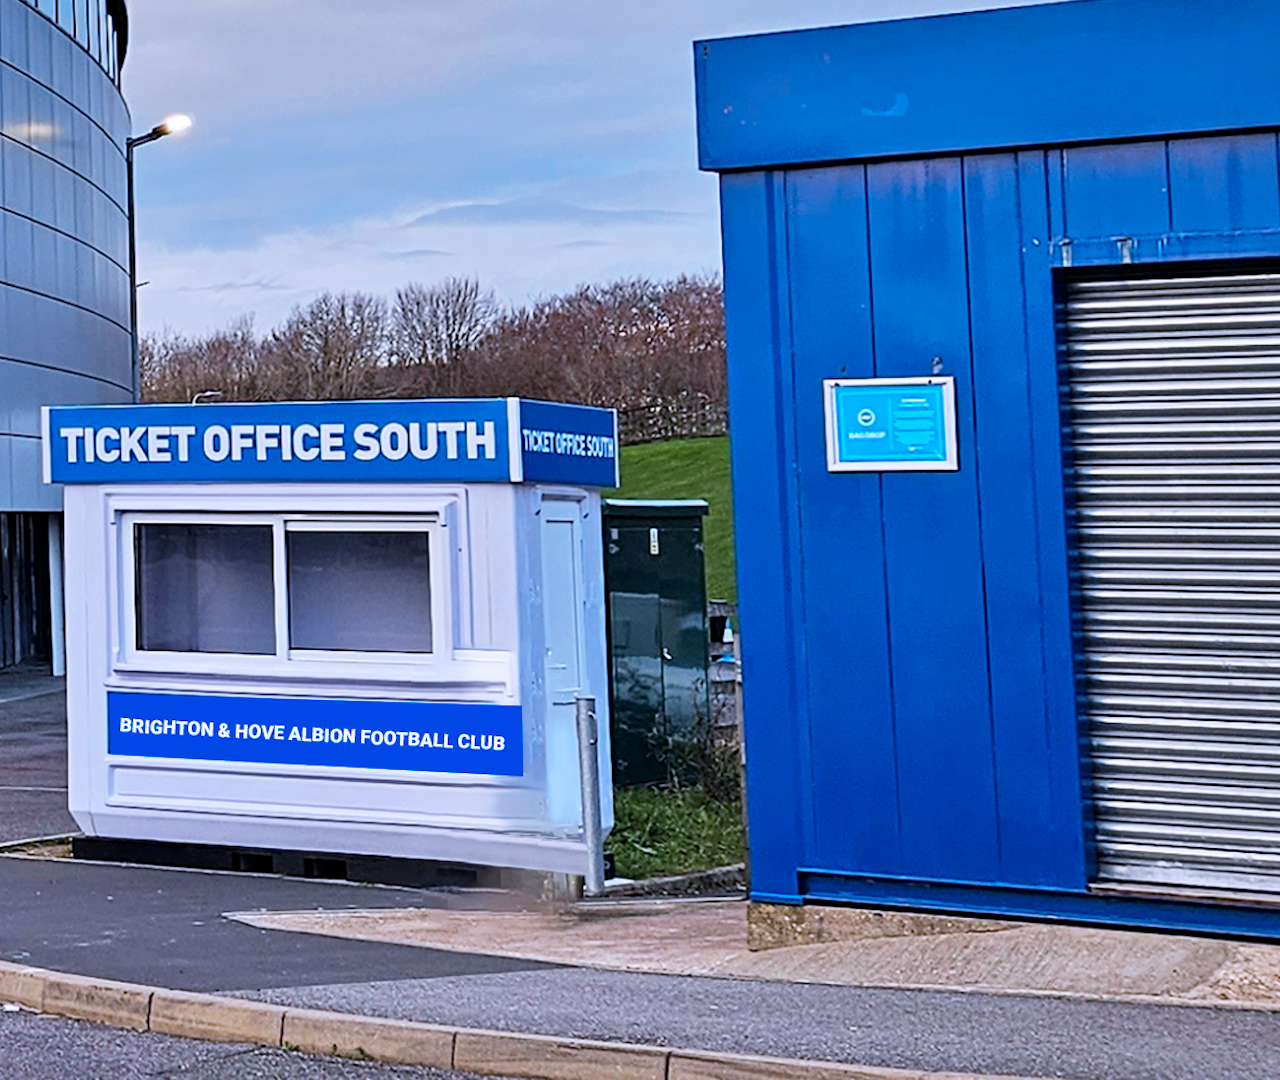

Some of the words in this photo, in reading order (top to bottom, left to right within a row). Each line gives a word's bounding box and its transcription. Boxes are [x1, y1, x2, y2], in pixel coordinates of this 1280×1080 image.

[60, 426, 195, 463] TICKET
[203, 424, 347, 462] OFFICE
[353, 421, 496, 460] SOUTH
[522, 428, 555, 453] TICKET
[555, 432, 586, 456] OFFICE
[586, 434, 615, 458] SOUTH
[119, 717, 214, 738] BRIGHTON
[218, 722, 231, 739] &
[235, 724, 285, 740] HOVE
[288, 726, 356, 743] ALBION
[360, 729, 454, 749] FOOTBALL
[457, 733, 505, 751] CLUB
